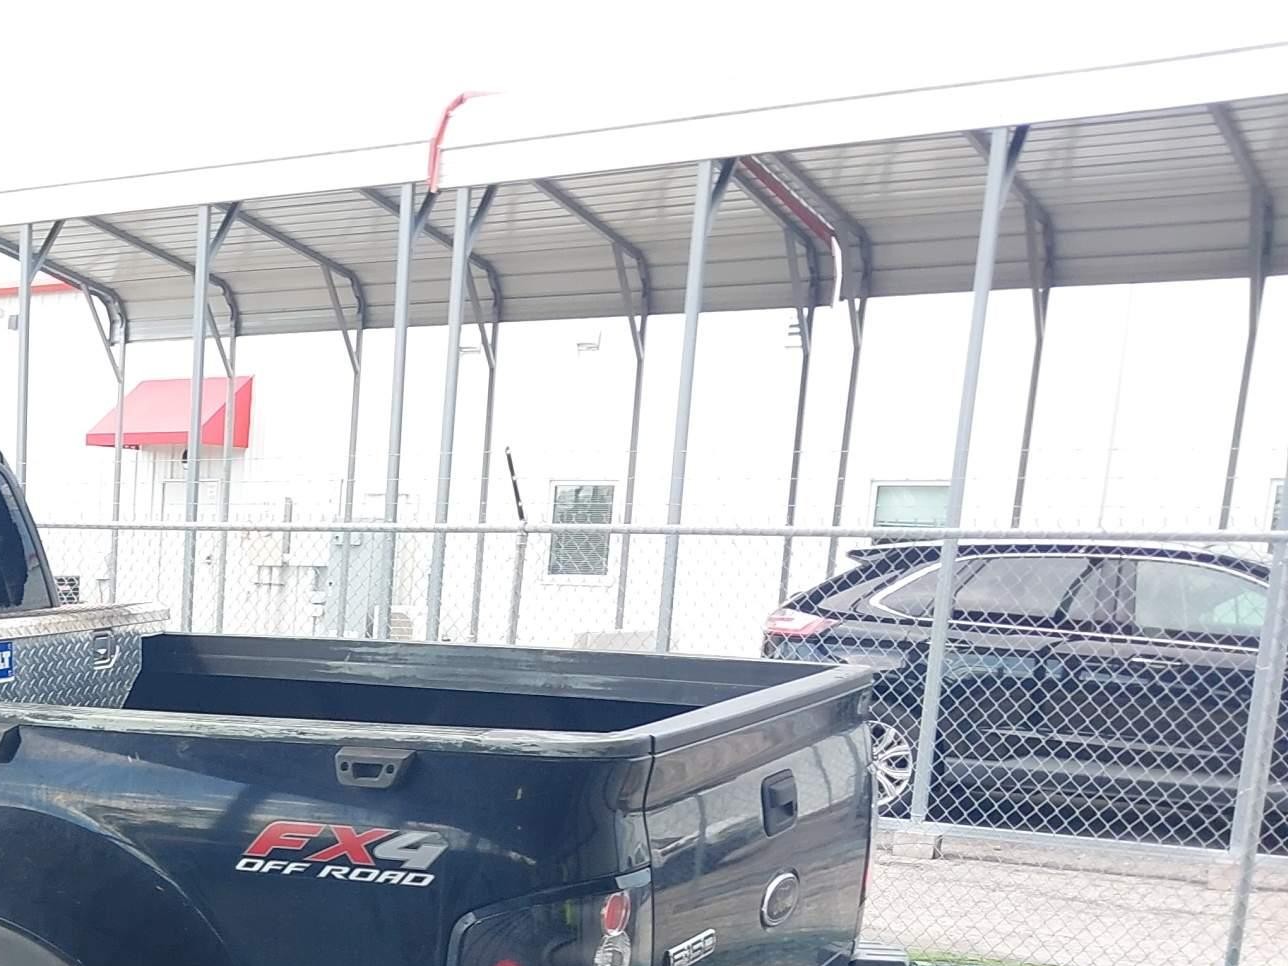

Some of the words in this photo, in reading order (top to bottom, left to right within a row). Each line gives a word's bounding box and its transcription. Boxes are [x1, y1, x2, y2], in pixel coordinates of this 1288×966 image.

[241, 820, 449, 870] FX4
[235, 857, 312, 875] OFF
[316, 865, 436, 887] ROAD
